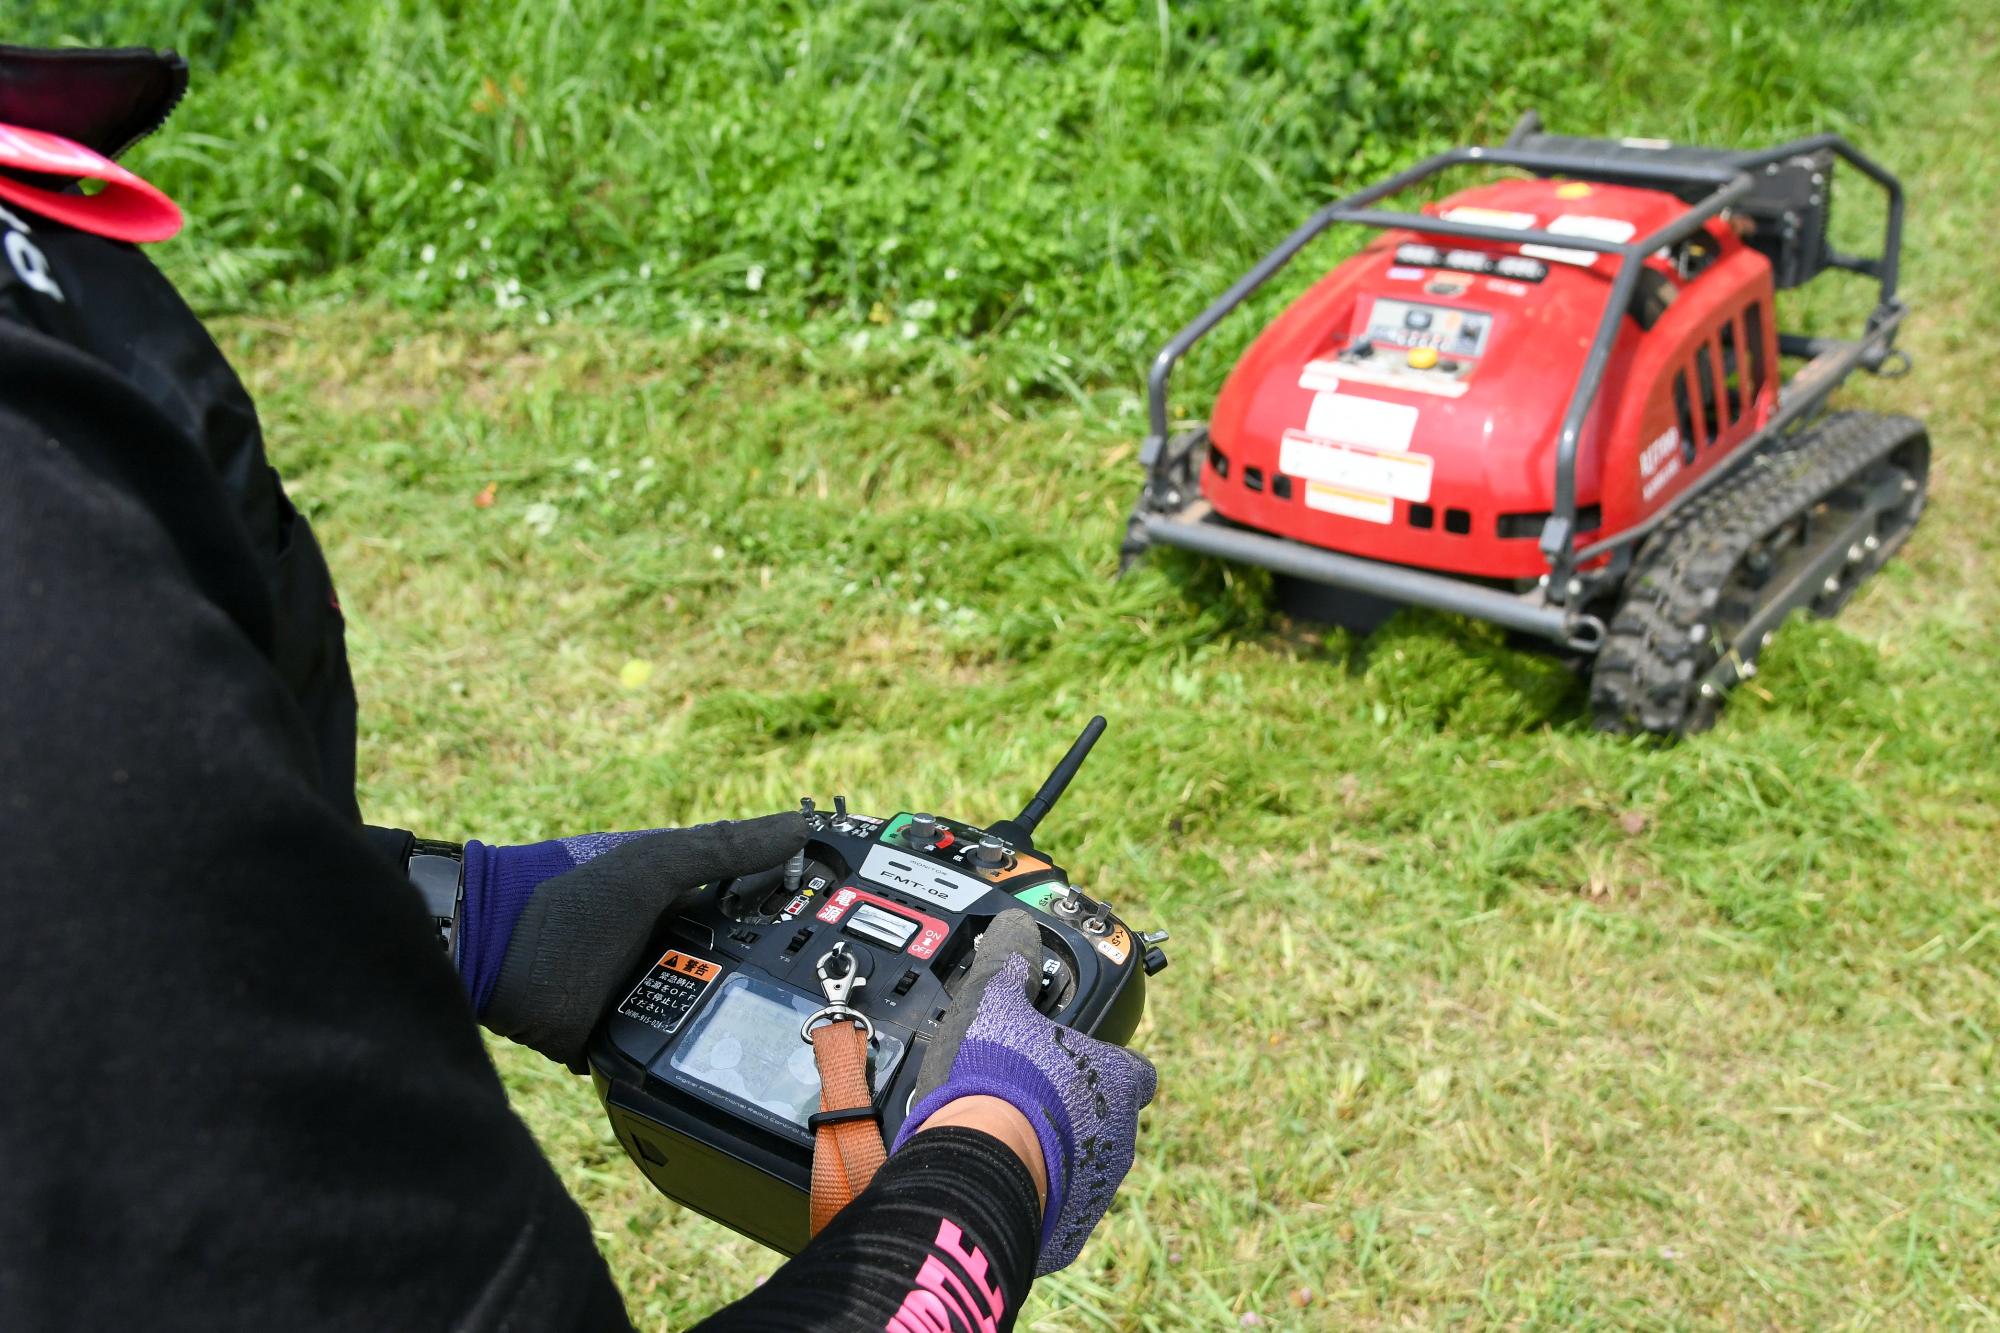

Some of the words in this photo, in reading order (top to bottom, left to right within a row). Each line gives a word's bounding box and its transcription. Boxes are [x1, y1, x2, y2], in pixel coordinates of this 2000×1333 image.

[880, 870, 949, 899] FMT-02
[925, 929, 942, 941] ON
[911, 944, 933, 956] OFF
[682, 958, 710, 977] 警告
